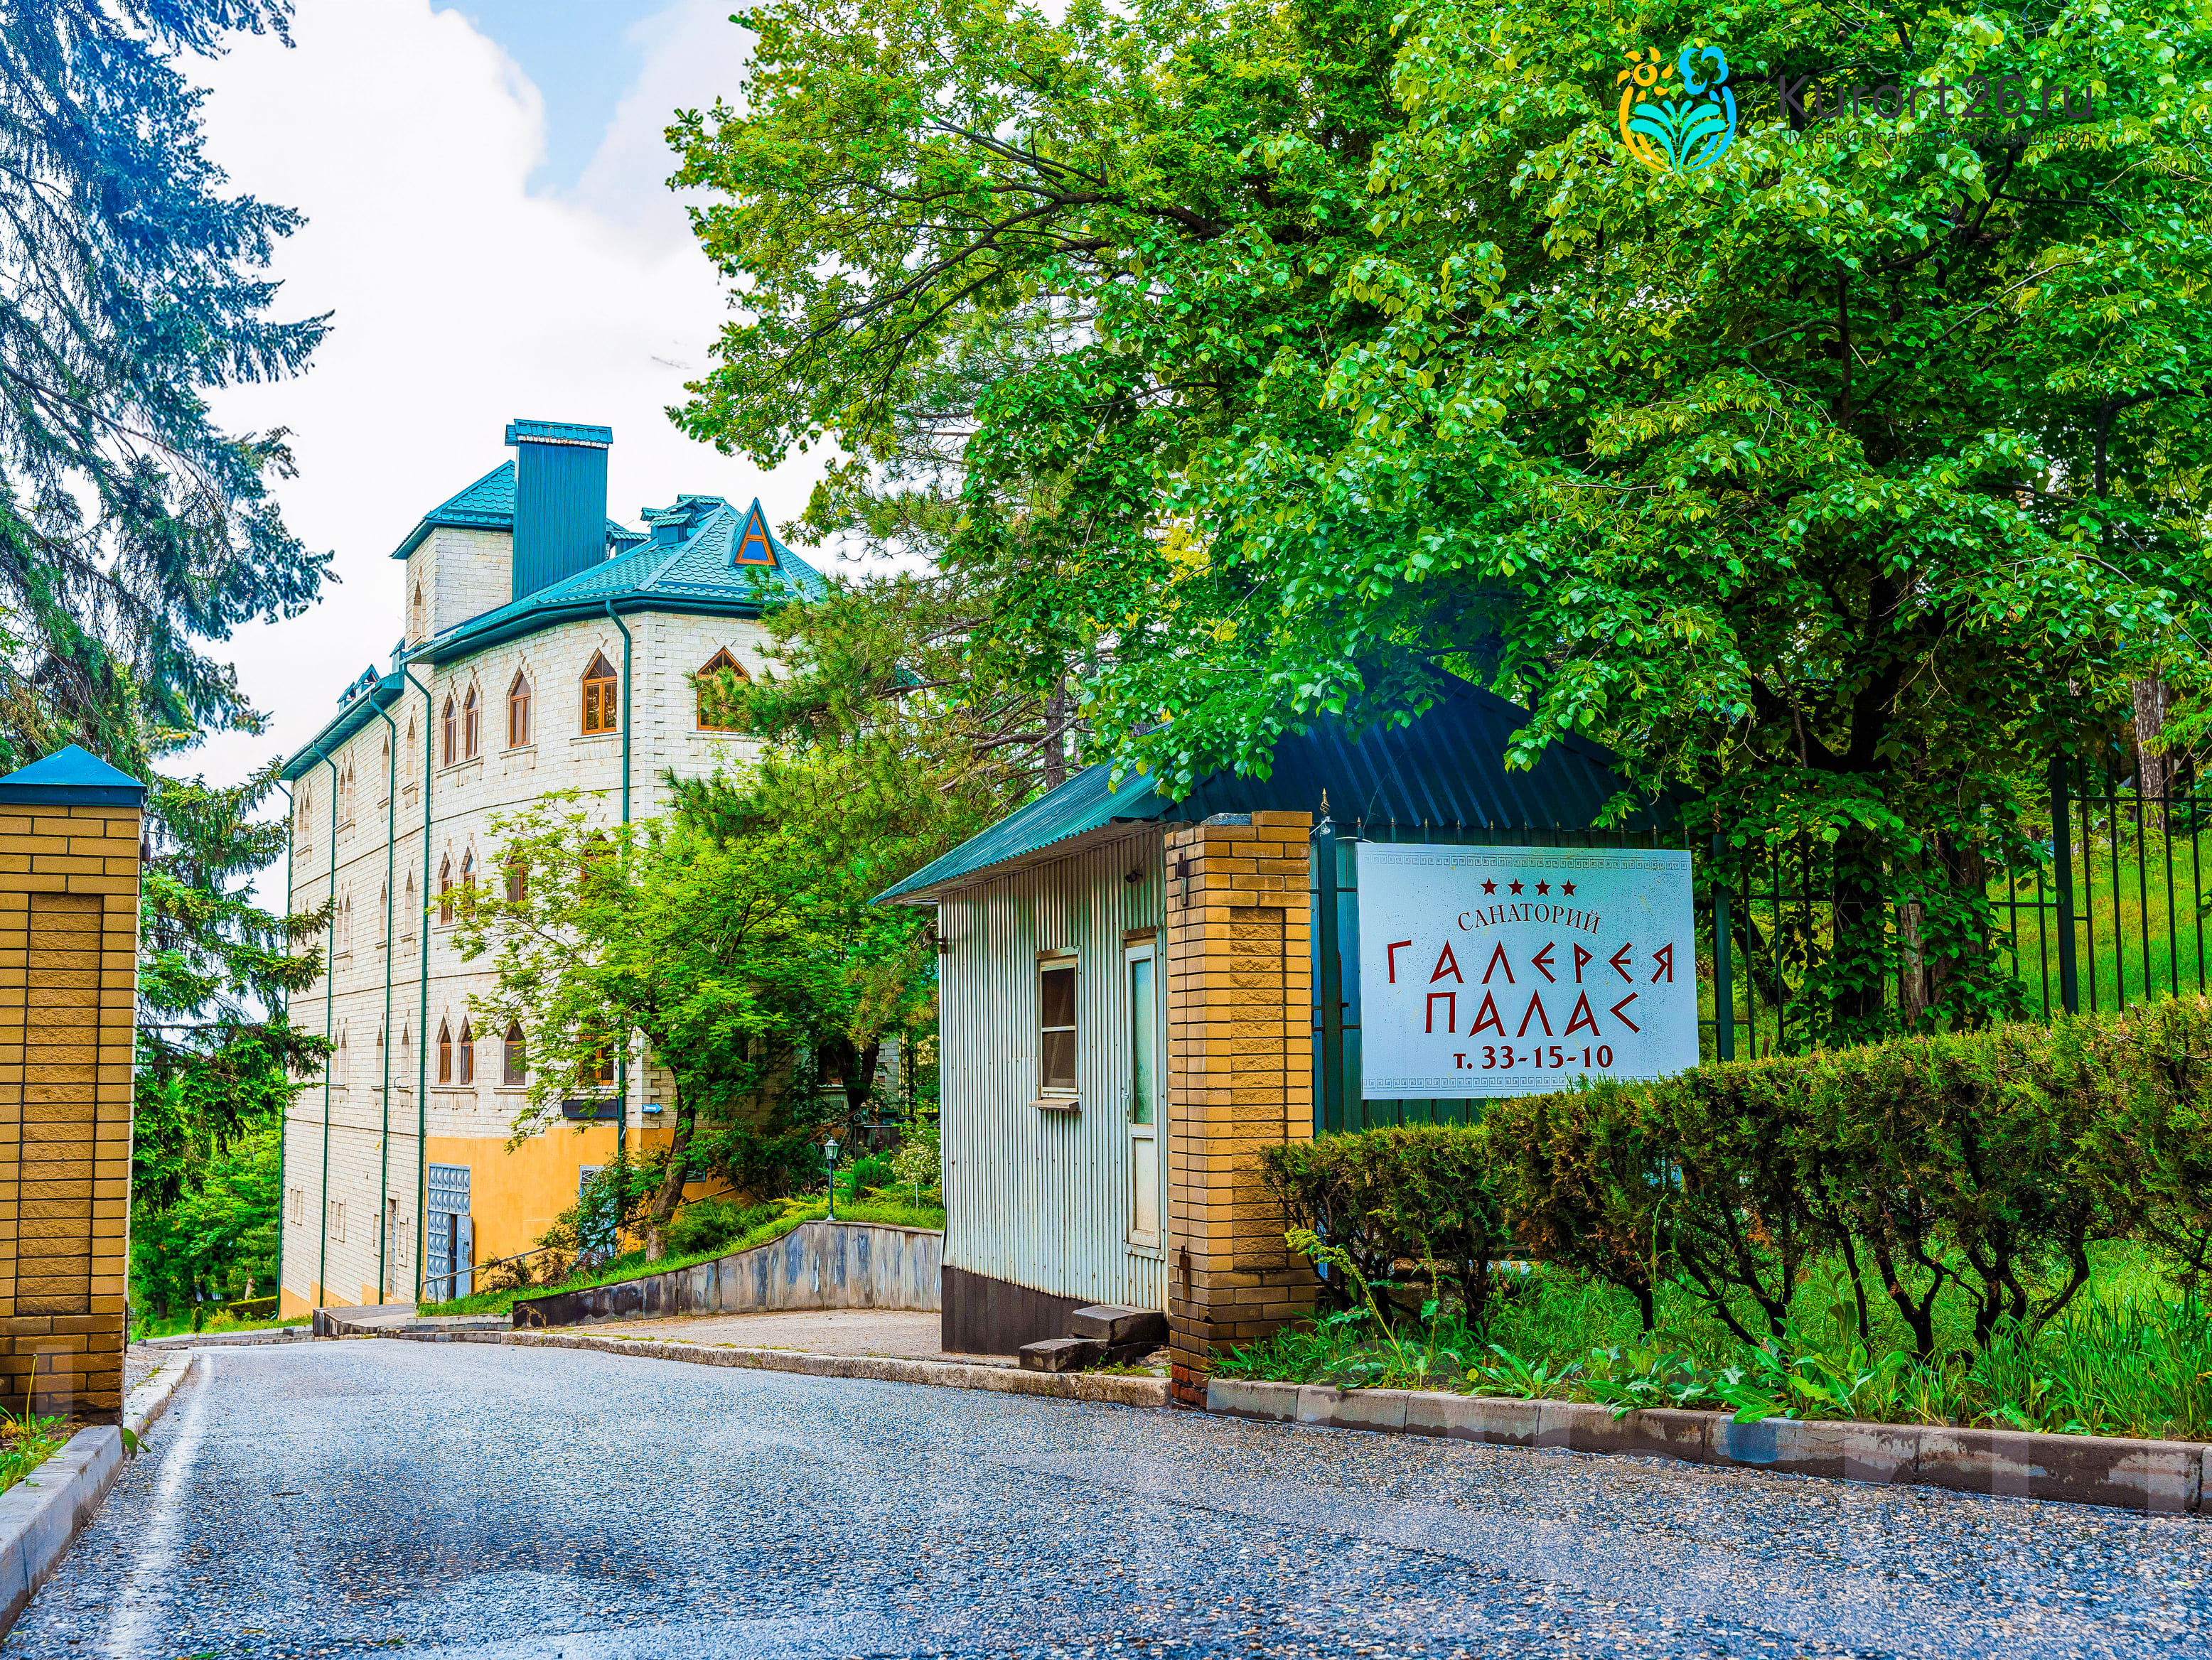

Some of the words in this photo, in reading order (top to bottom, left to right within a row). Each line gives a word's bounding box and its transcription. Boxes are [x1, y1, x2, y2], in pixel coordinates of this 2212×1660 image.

[1457, 902, 1601, 934] САНАТОРИЙ
[1387, 939, 1674, 984] ГАЛЕРЕЯ
[1424, 988, 1641, 1038] ПАЛАС
[1452, 1052, 1473, 1069] т.
[1481, 1045, 1614, 1069] 33-15-10
